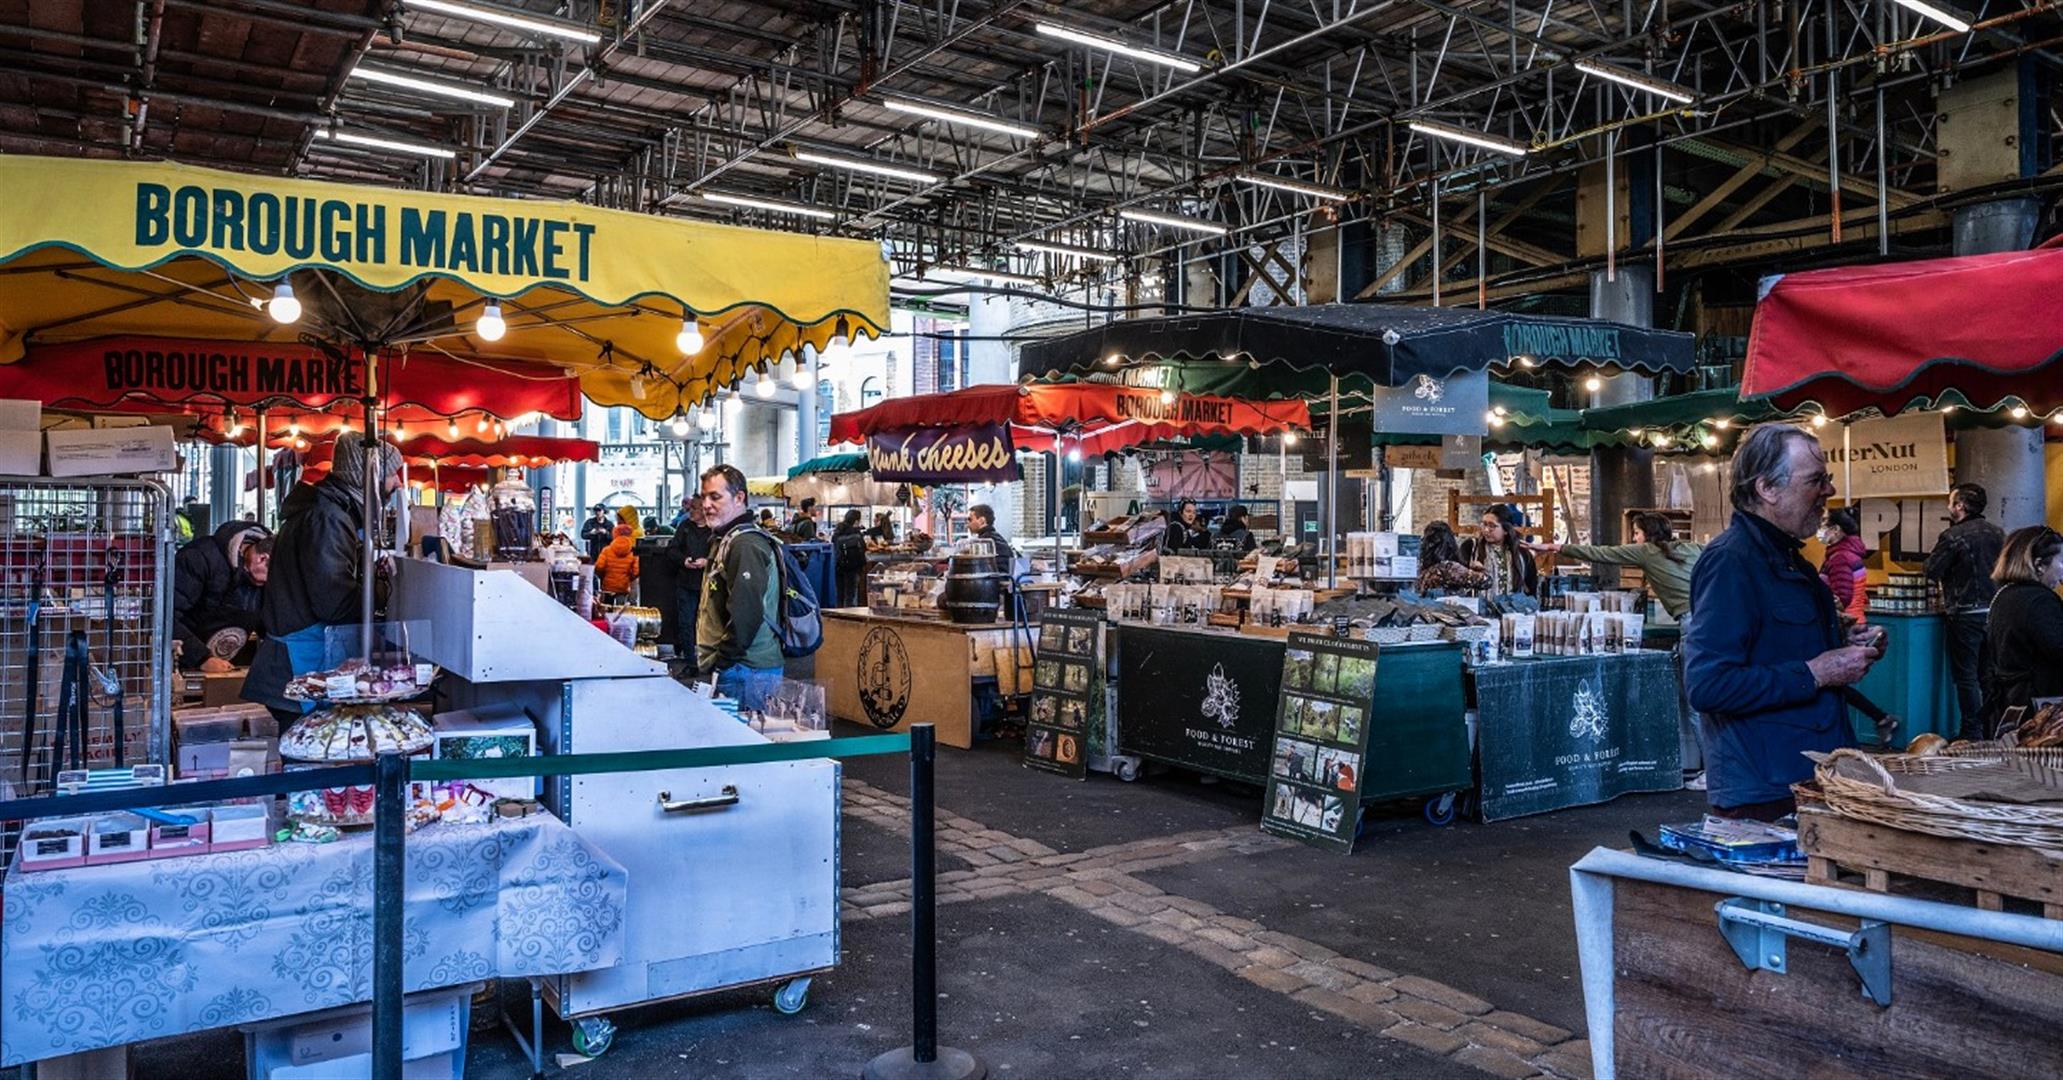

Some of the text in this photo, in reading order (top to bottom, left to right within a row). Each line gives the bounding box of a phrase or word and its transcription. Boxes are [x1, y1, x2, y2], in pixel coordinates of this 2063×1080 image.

[135, 183, 596, 283] BOROUGH MARKET
[1567, 326, 1621, 358] MARKET
[103, 351, 364, 395] BOROUGH MARKE
[1182, 400, 1233, 425] MARKET
[918, 432, 1011, 473] cheeses
[1871, 464, 1918, 474] LONDON
[1185, 728, 1209, 740] FOOD
[1220, 735, 1256, 750] FOREST
[1555, 753, 1580, 766] FOOD
